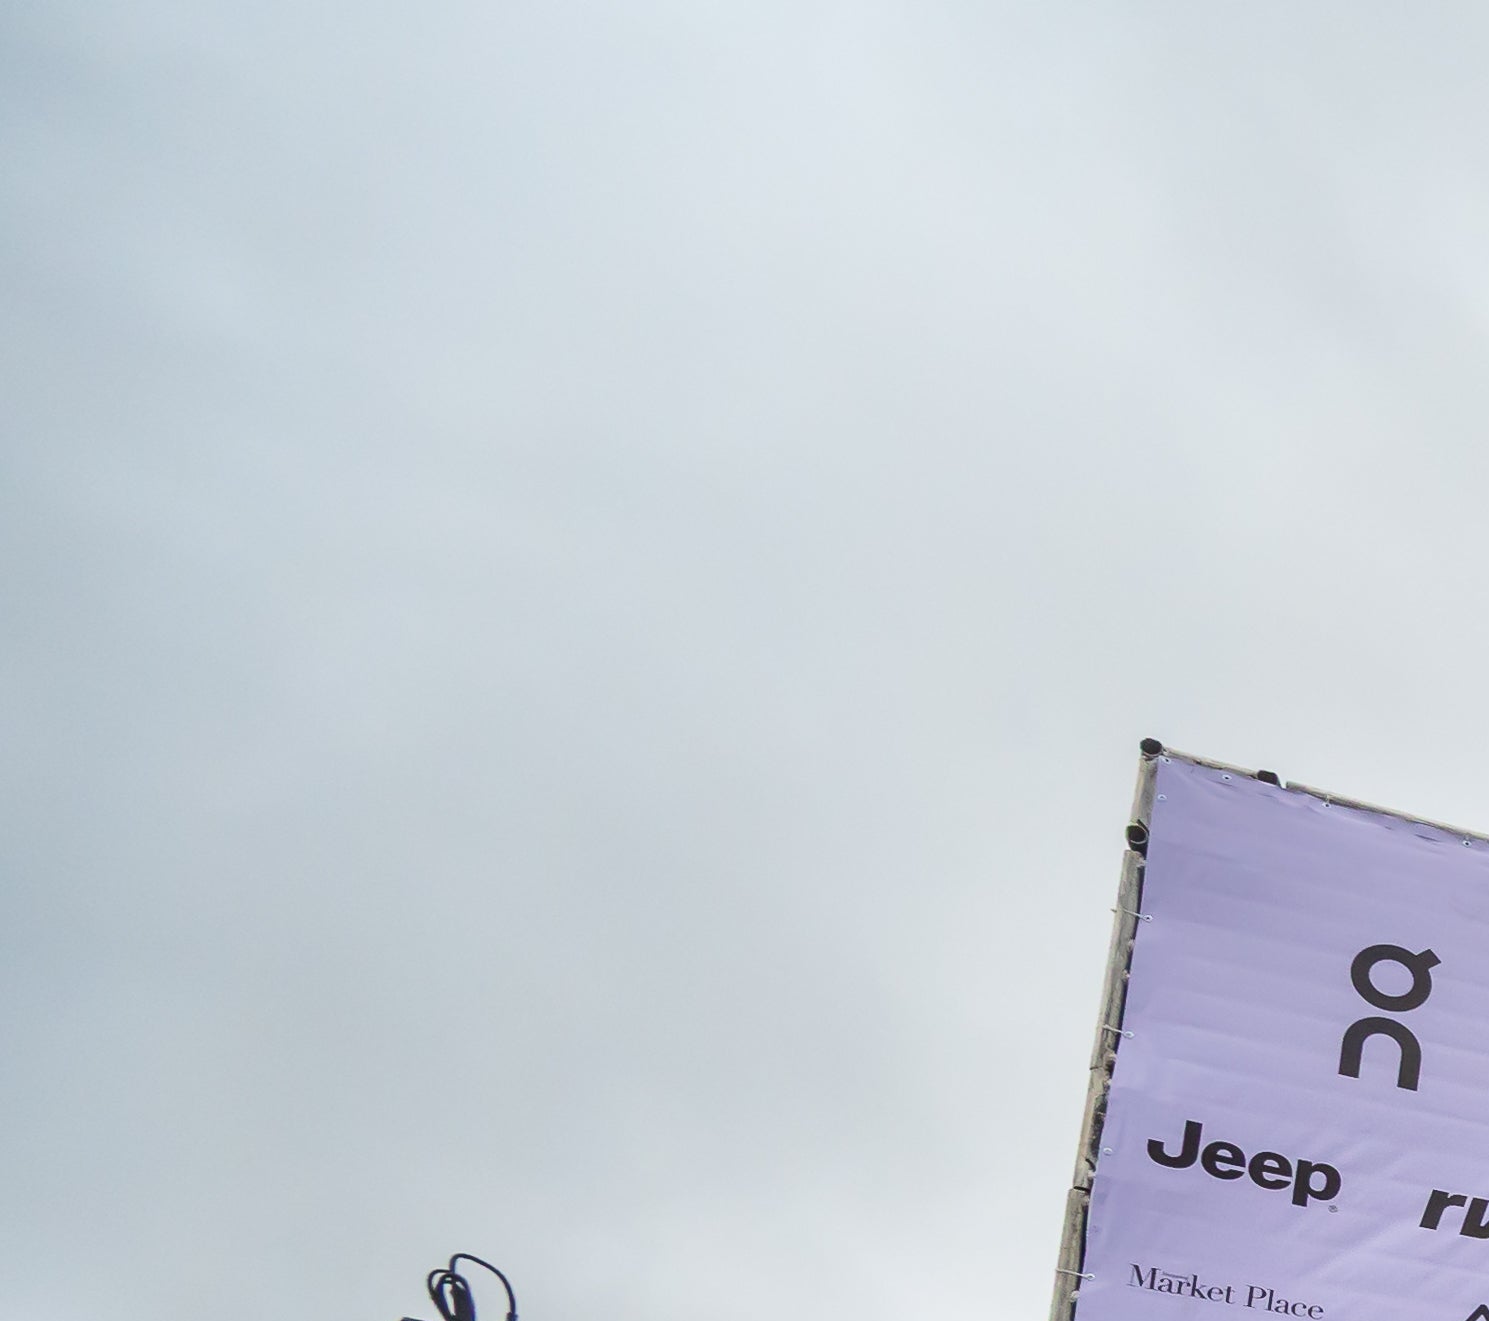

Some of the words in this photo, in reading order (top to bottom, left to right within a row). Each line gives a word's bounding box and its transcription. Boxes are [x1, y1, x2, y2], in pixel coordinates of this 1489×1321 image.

[1147, 1119, 1342, 1208] Jeep
[1126, 1262, 1237, 1305] Market
[1243, 1284, 1325, 1321] Place
